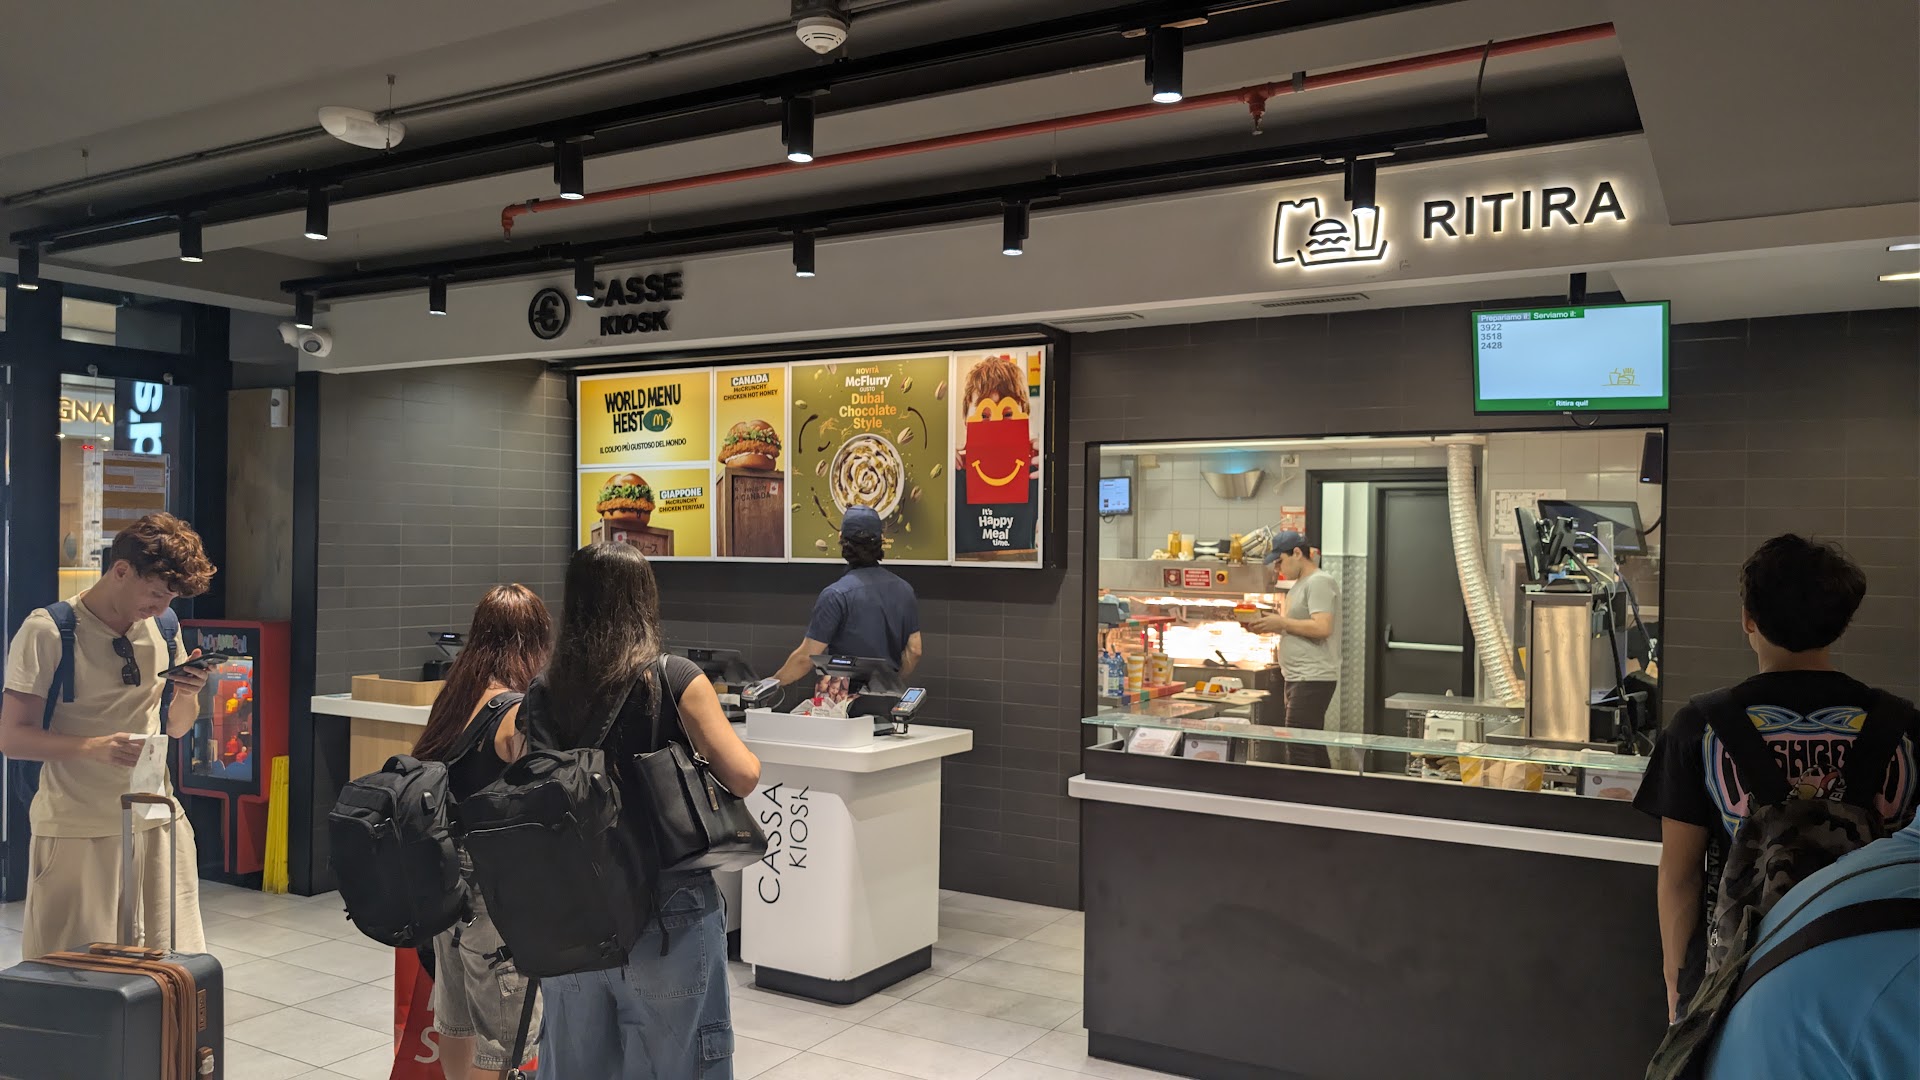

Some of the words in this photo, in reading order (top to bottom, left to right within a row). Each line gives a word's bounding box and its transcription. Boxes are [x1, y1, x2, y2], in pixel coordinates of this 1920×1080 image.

[1423, 181, 1627, 240] RITIRA
[586, 272, 684, 308] CASSE
[600, 309, 671, 336] KIOSK
[1480, 314, 1522, 322] Prepariamo
[856, 365, 879, 375] NOVITÀ
[732, 373, 768, 386] CANADA
[845, 374, 891, 388] McFlurry
[605, 389, 646, 413] WORLD
[647, 384, 681, 408] MENU
[723, 393, 747, 401] CHICKEN
[759, 389, 778, 397] HONEY
[851, 391, 885, 404] Dubai
[1575, 400, 1589, 408] qui!
[59, 397, 114, 425] GNA
[839, 405, 897, 417] Chocolate
[613, 411, 644, 434] HEIST
[853, 417, 883, 432] Style
[605, 445, 622, 454] COLPO
[622, 442, 630, 452] PIÙ
[630, 441, 655, 450] GUSTOSO
[655, 440, 665, 448] DEL
[666, 438, 687, 447] MONDO
[660, 488, 702, 499] GIAPPONE
[659, 505, 682, 513] CHICKEN
[978, 516, 1014, 529] Happy
[982, 528, 1009, 540] Meal
[789, 785, 809, 868] KIOSK
[758, 782, 783, 904] CASSA
